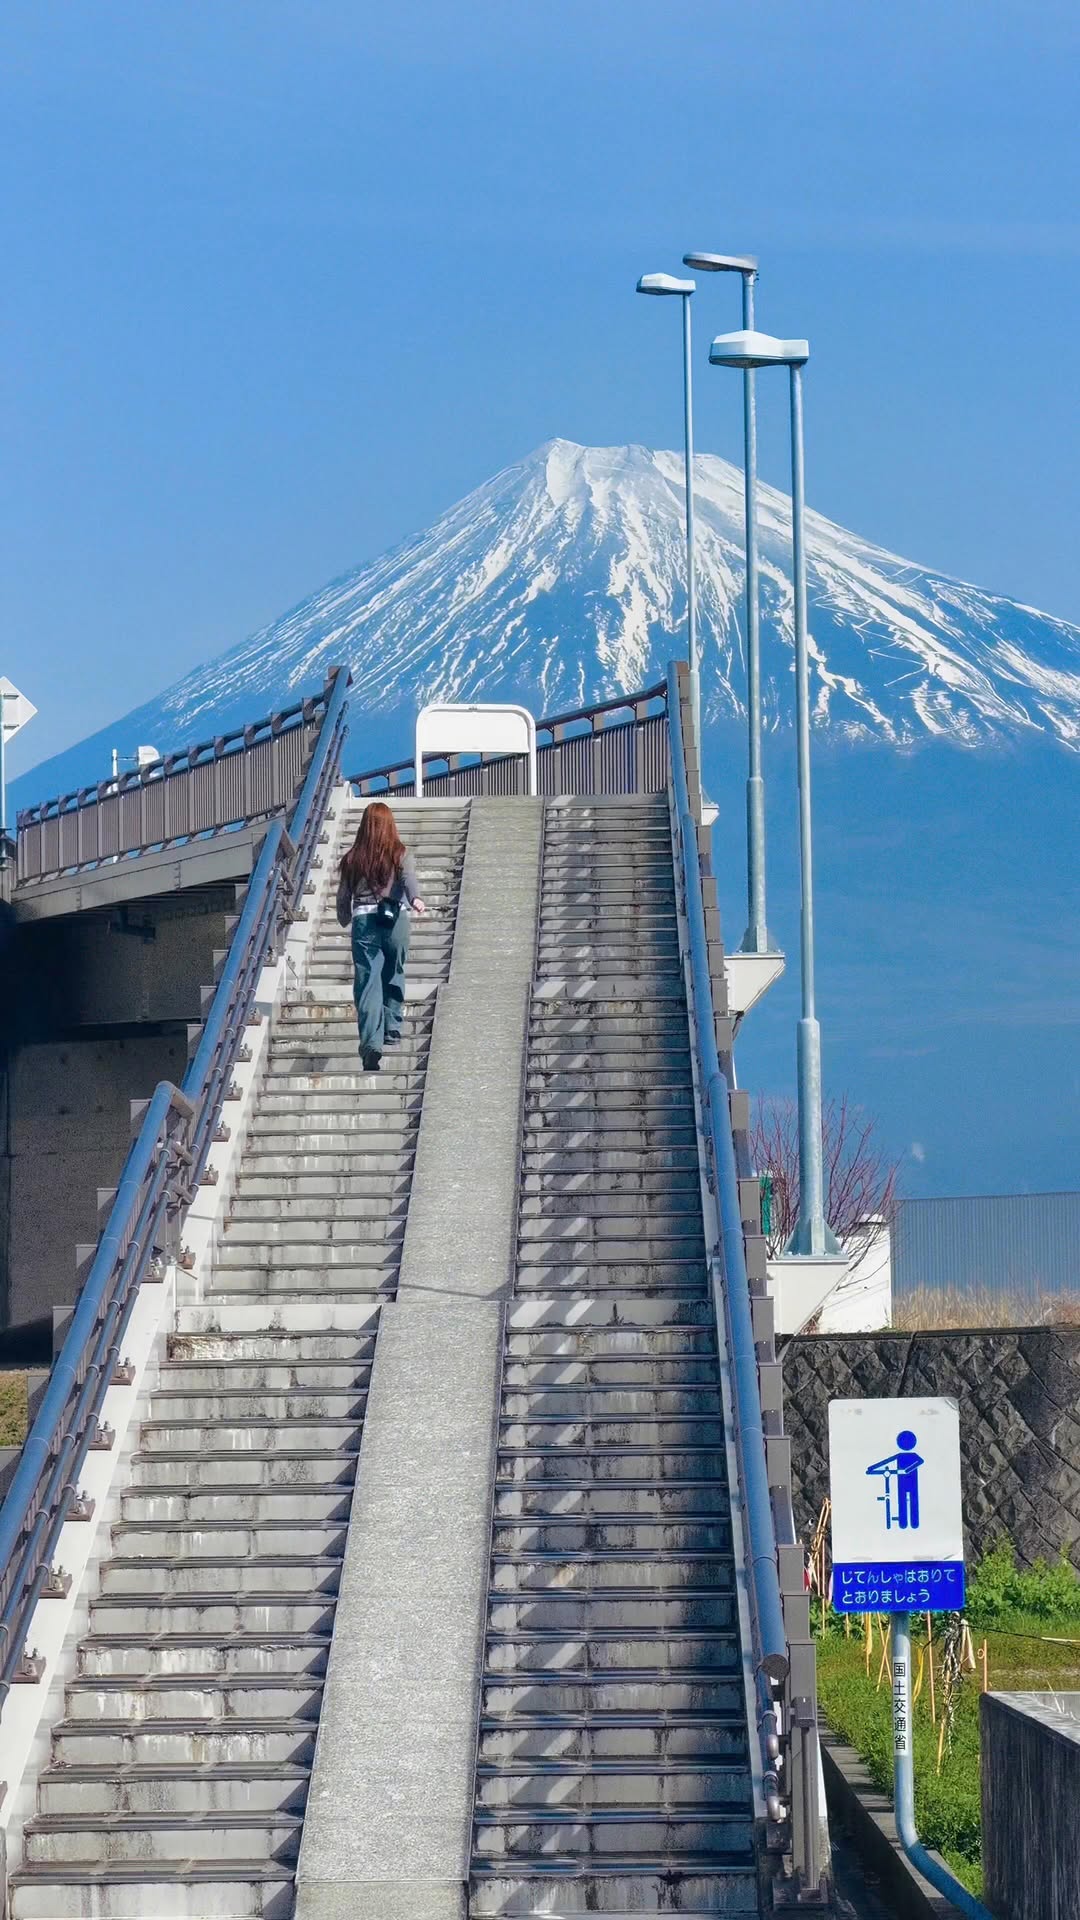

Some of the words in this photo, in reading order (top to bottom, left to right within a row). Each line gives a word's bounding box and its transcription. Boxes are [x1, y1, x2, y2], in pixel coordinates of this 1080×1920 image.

[841, 1568, 956, 1585] じてんしゃはおりて
[841, 1588, 931, 1604] とおりましょう
[893, 1662, 907, 1750] 国土交通省
